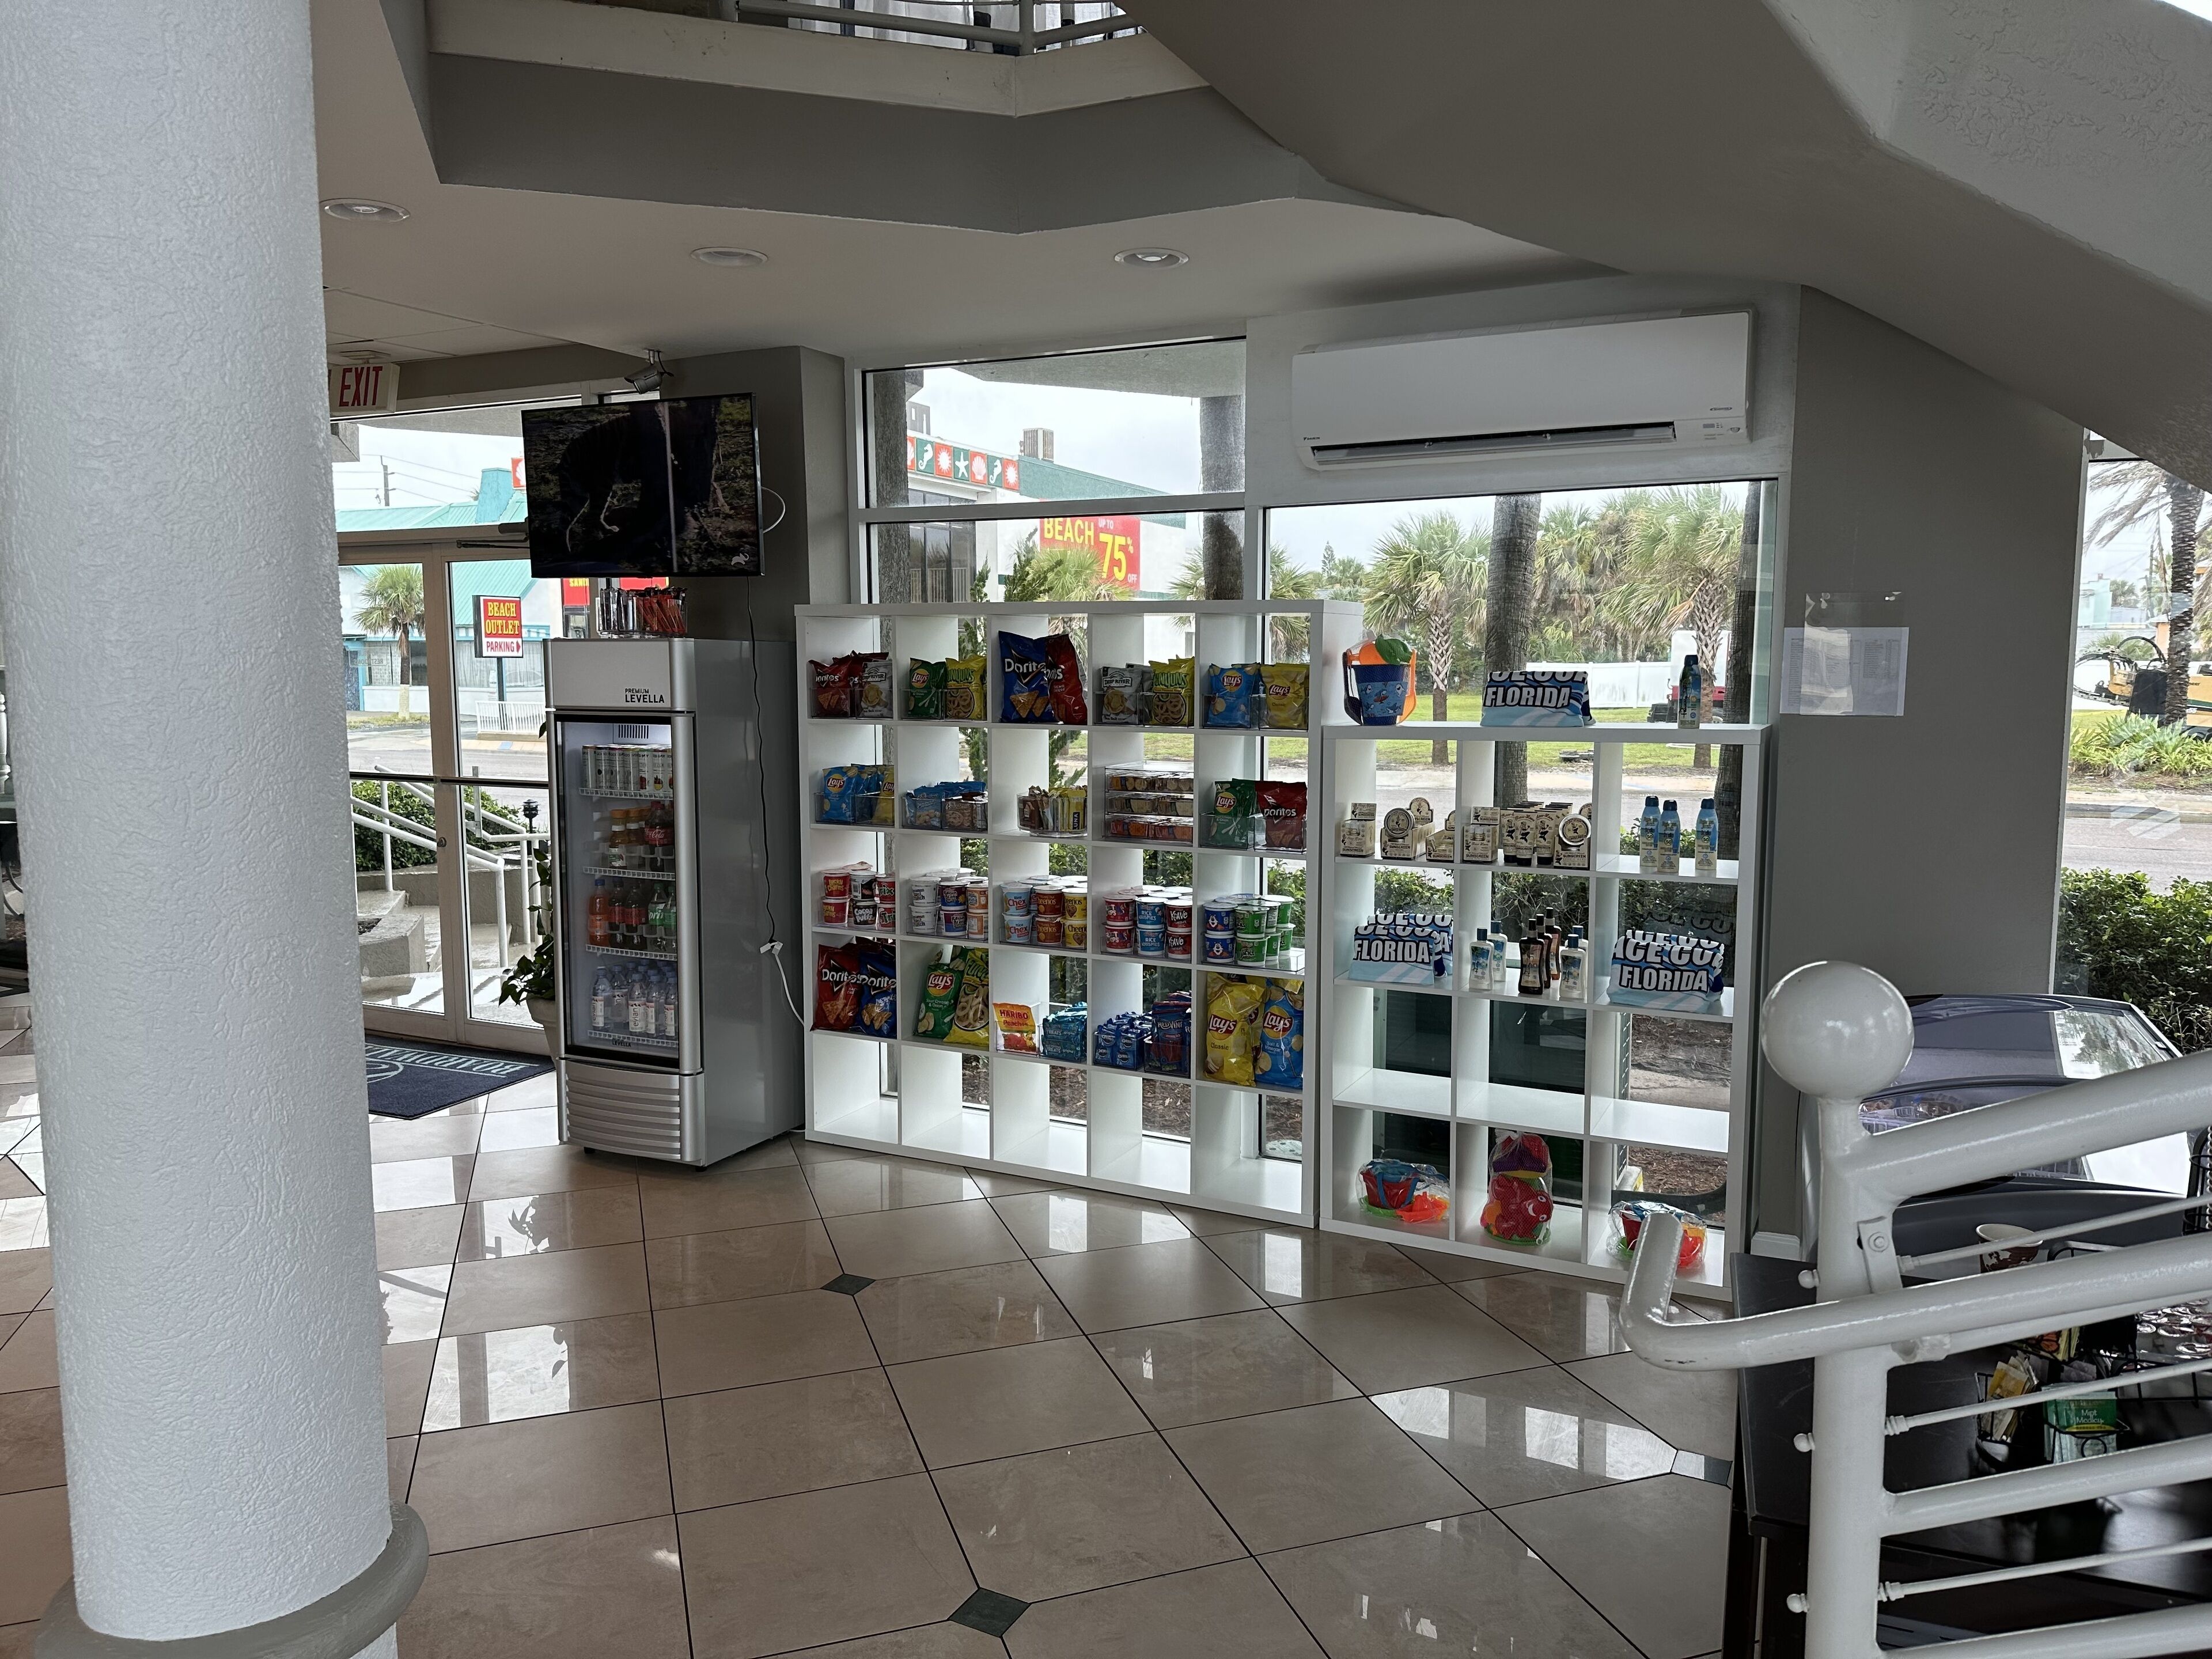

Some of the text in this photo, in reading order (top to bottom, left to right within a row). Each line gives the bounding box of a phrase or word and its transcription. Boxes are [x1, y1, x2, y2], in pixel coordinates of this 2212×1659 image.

[339, 366, 382, 407] EXIT
[1099, 518, 1113, 529] UP TO
[1044, 517, 1094, 546] BEACH
[1127, 574, 1138, 584] OFF
[487, 602, 516, 617] BEACH
[486, 619, 520, 635] OUTLET
[487, 641, 514, 653] PARKING
[912, 673, 929, 684] Lay's
[1224, 675, 1241, 687] Lay's
[1270, 685, 1290, 696] Lay's
[625, 694, 664, 703] LEVELLA
[1484, 685, 1571, 709] FLORIDA
[827, 778, 844, 789] Lay's
[884, 782, 894, 792] Lay
[1216, 796, 1235, 808] Lay's
[1264, 808, 1296, 817] Doritos
[1008, 899, 1027, 907] Chex
[881, 912, 895, 924] Tri
[1009, 926, 1028, 934] Chex
[1354, 940, 1430, 963] FLORIDA
[860, 974, 896, 989] Dorito
[928, 974, 953, 990] Lay's
[1620, 965, 1708, 992] FLORIDA
[999, 1009, 1029, 1019] HARIBO
[1209, 1014, 1236, 1034] Lay's
[1263, 1012, 1292, 1032] Lay's
[1210, 1042, 1229, 1051] Classic
[2076, 1416, 2104, 1426] Medley
